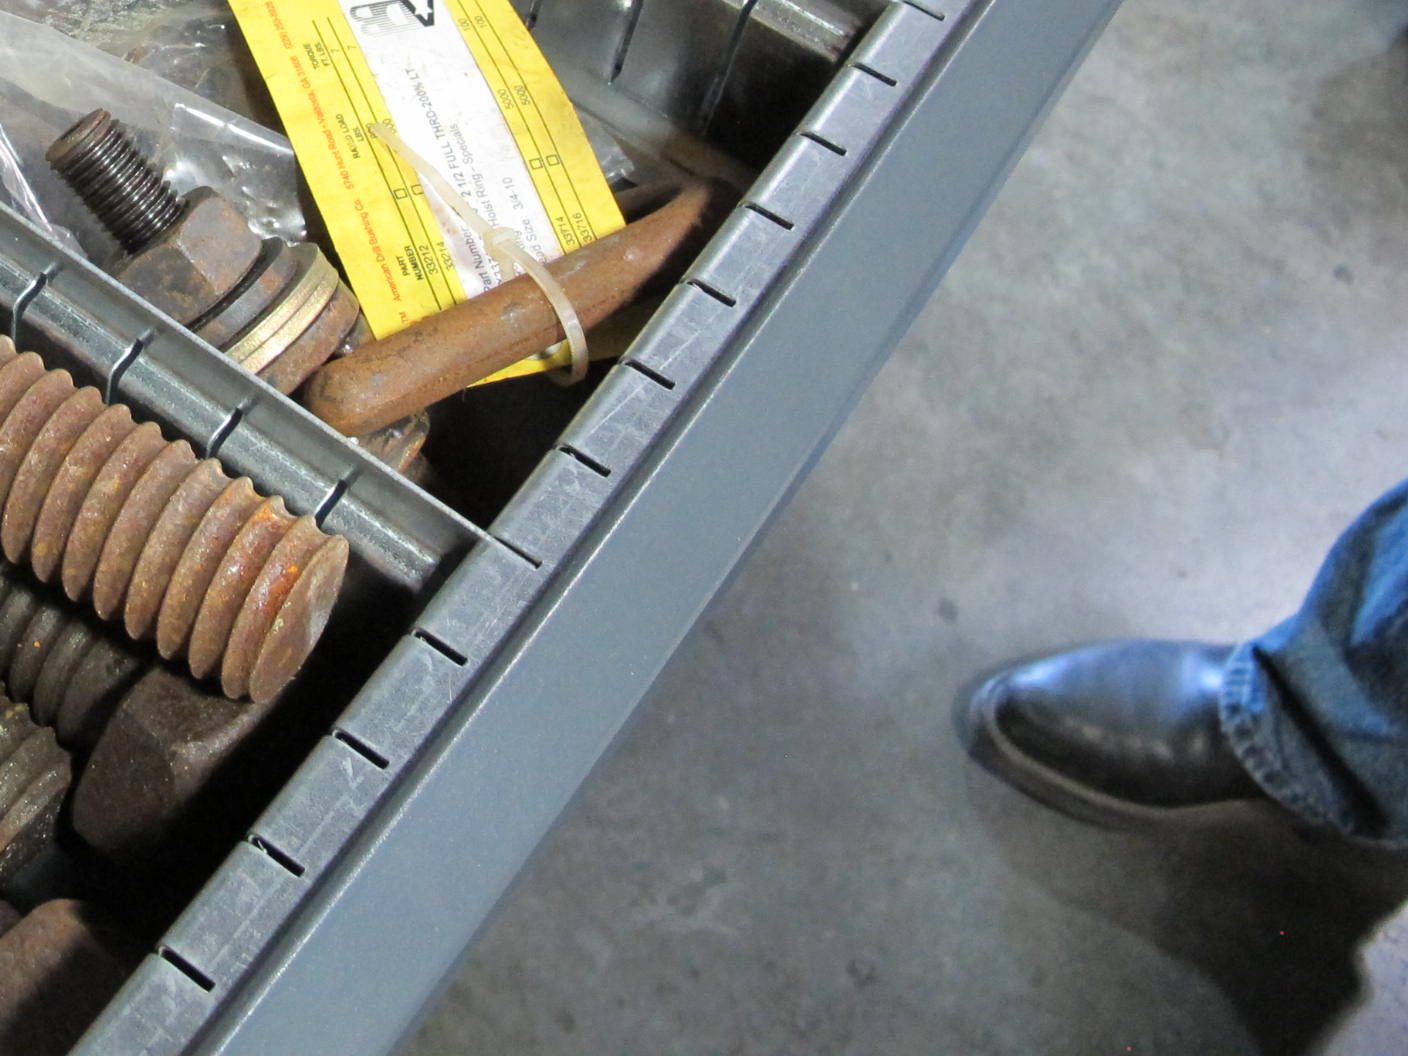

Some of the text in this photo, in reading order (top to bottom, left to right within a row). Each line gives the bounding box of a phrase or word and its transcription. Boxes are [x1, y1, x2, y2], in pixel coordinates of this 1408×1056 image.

[457, 17, 471, 32] 100
[473, 15, 485, 28] 100
[302, 43, 319, 70] TORQUE
[496, 88, 515, 110] 5000
[513, 84, 531, 106] 5000
[335, 113, 350, 133] LOAD
[322, 129, 337, 150] Road
[449, 122, 474, 165] Specials
[440, 140, 460, 170] FULL
[452, 171, 467, 188] 1/2
[471, 172, 488, 198] Ring
[459, 190, 472, 198] 2
[480, 199, 499, 230] Hoist
[359, 211, 378, 246] Bushing
[554, 215, 576, 246] 33714
[571, 212, 594, 245] 33716
[371, 245, 386, 263] Drill
[395, 255, 410, 277] PART
[404, 245, 423, 281] NUMBER
[417, 244, 439, 276] 33212
[435, 240, 455, 271] 33214
[380, 263, 401, 301] American
[477, 271, 495, 293] Part
